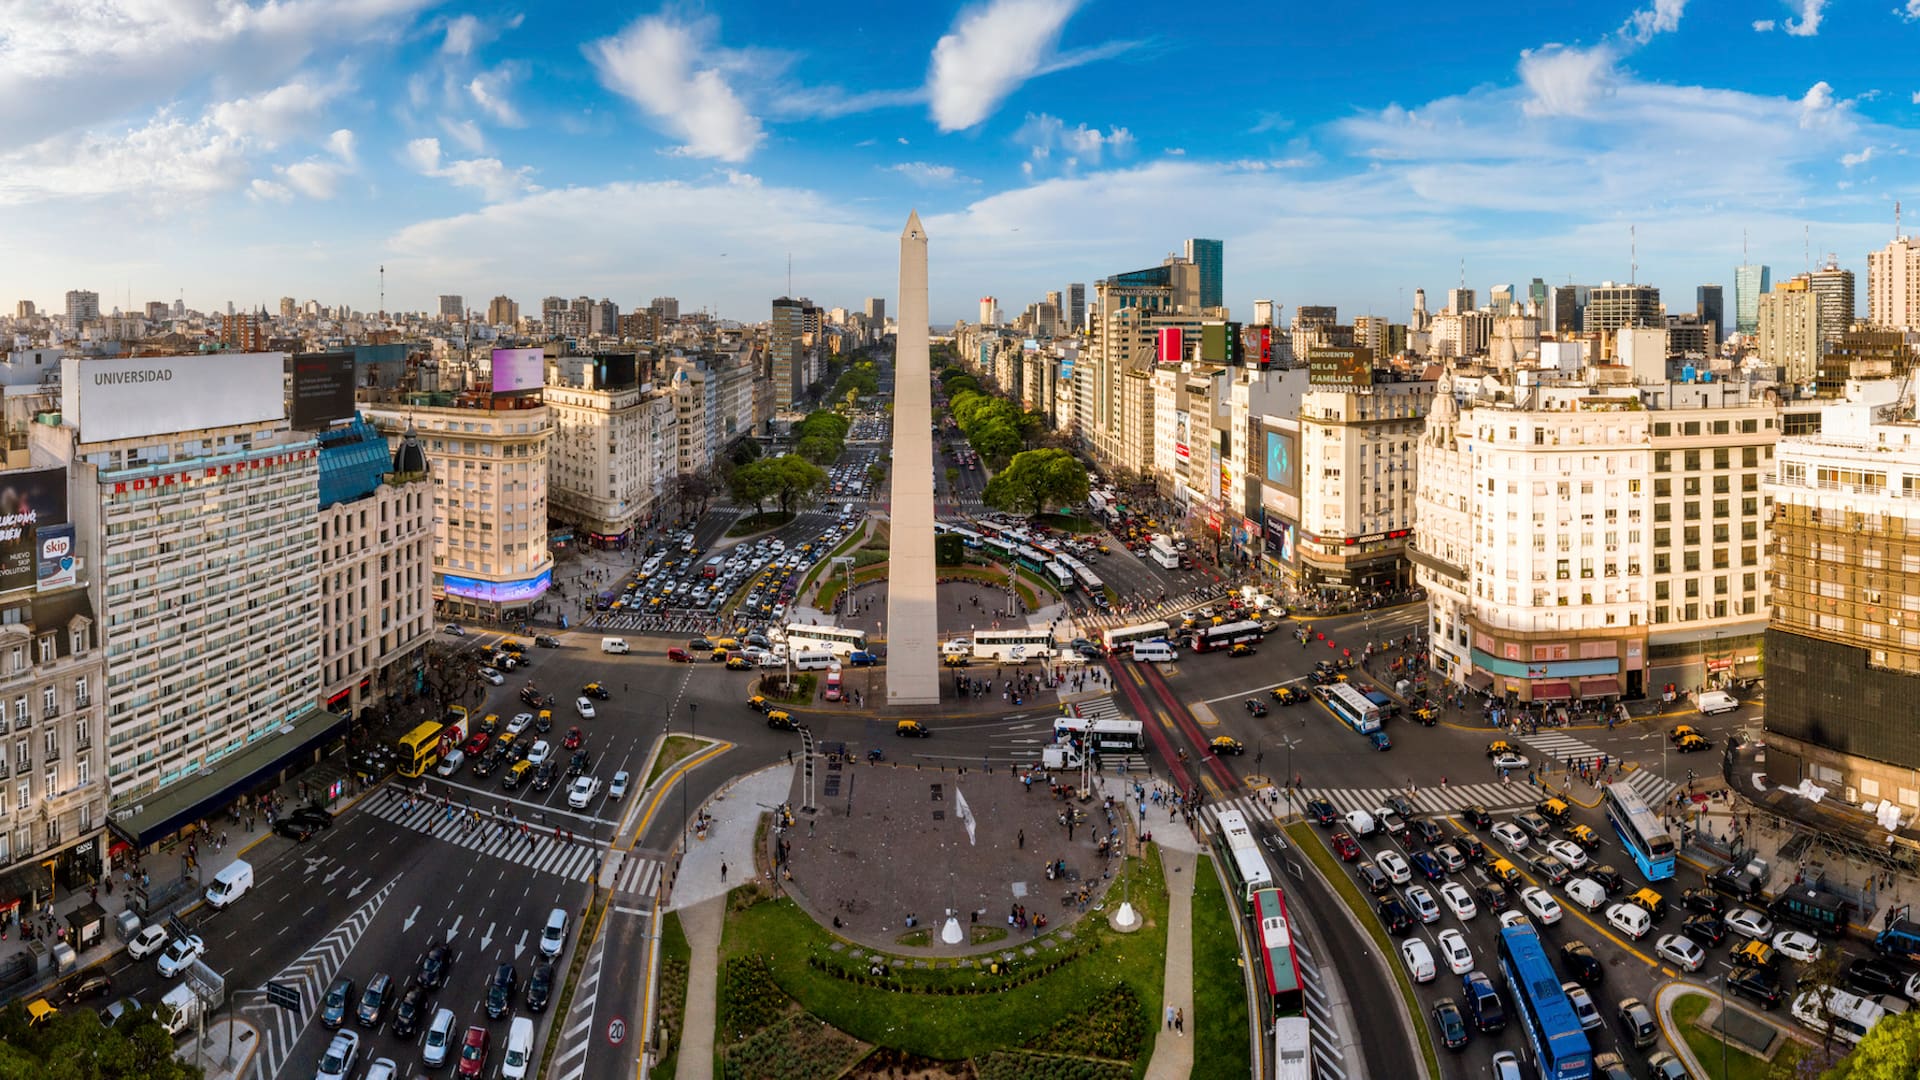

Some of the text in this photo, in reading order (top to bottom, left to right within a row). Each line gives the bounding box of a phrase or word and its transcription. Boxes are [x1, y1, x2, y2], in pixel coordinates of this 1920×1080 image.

[94, 368, 173, 386] UNIVERSIDAD
[1311, 374, 1353, 382] FAMILIAS
[114, 449, 317, 494] HOTEL REPUBLICA
[46, 540, 67, 553] skip
[10, 552, 30, 560] NUEVO
[611, 1023, 624, 1039] 20
